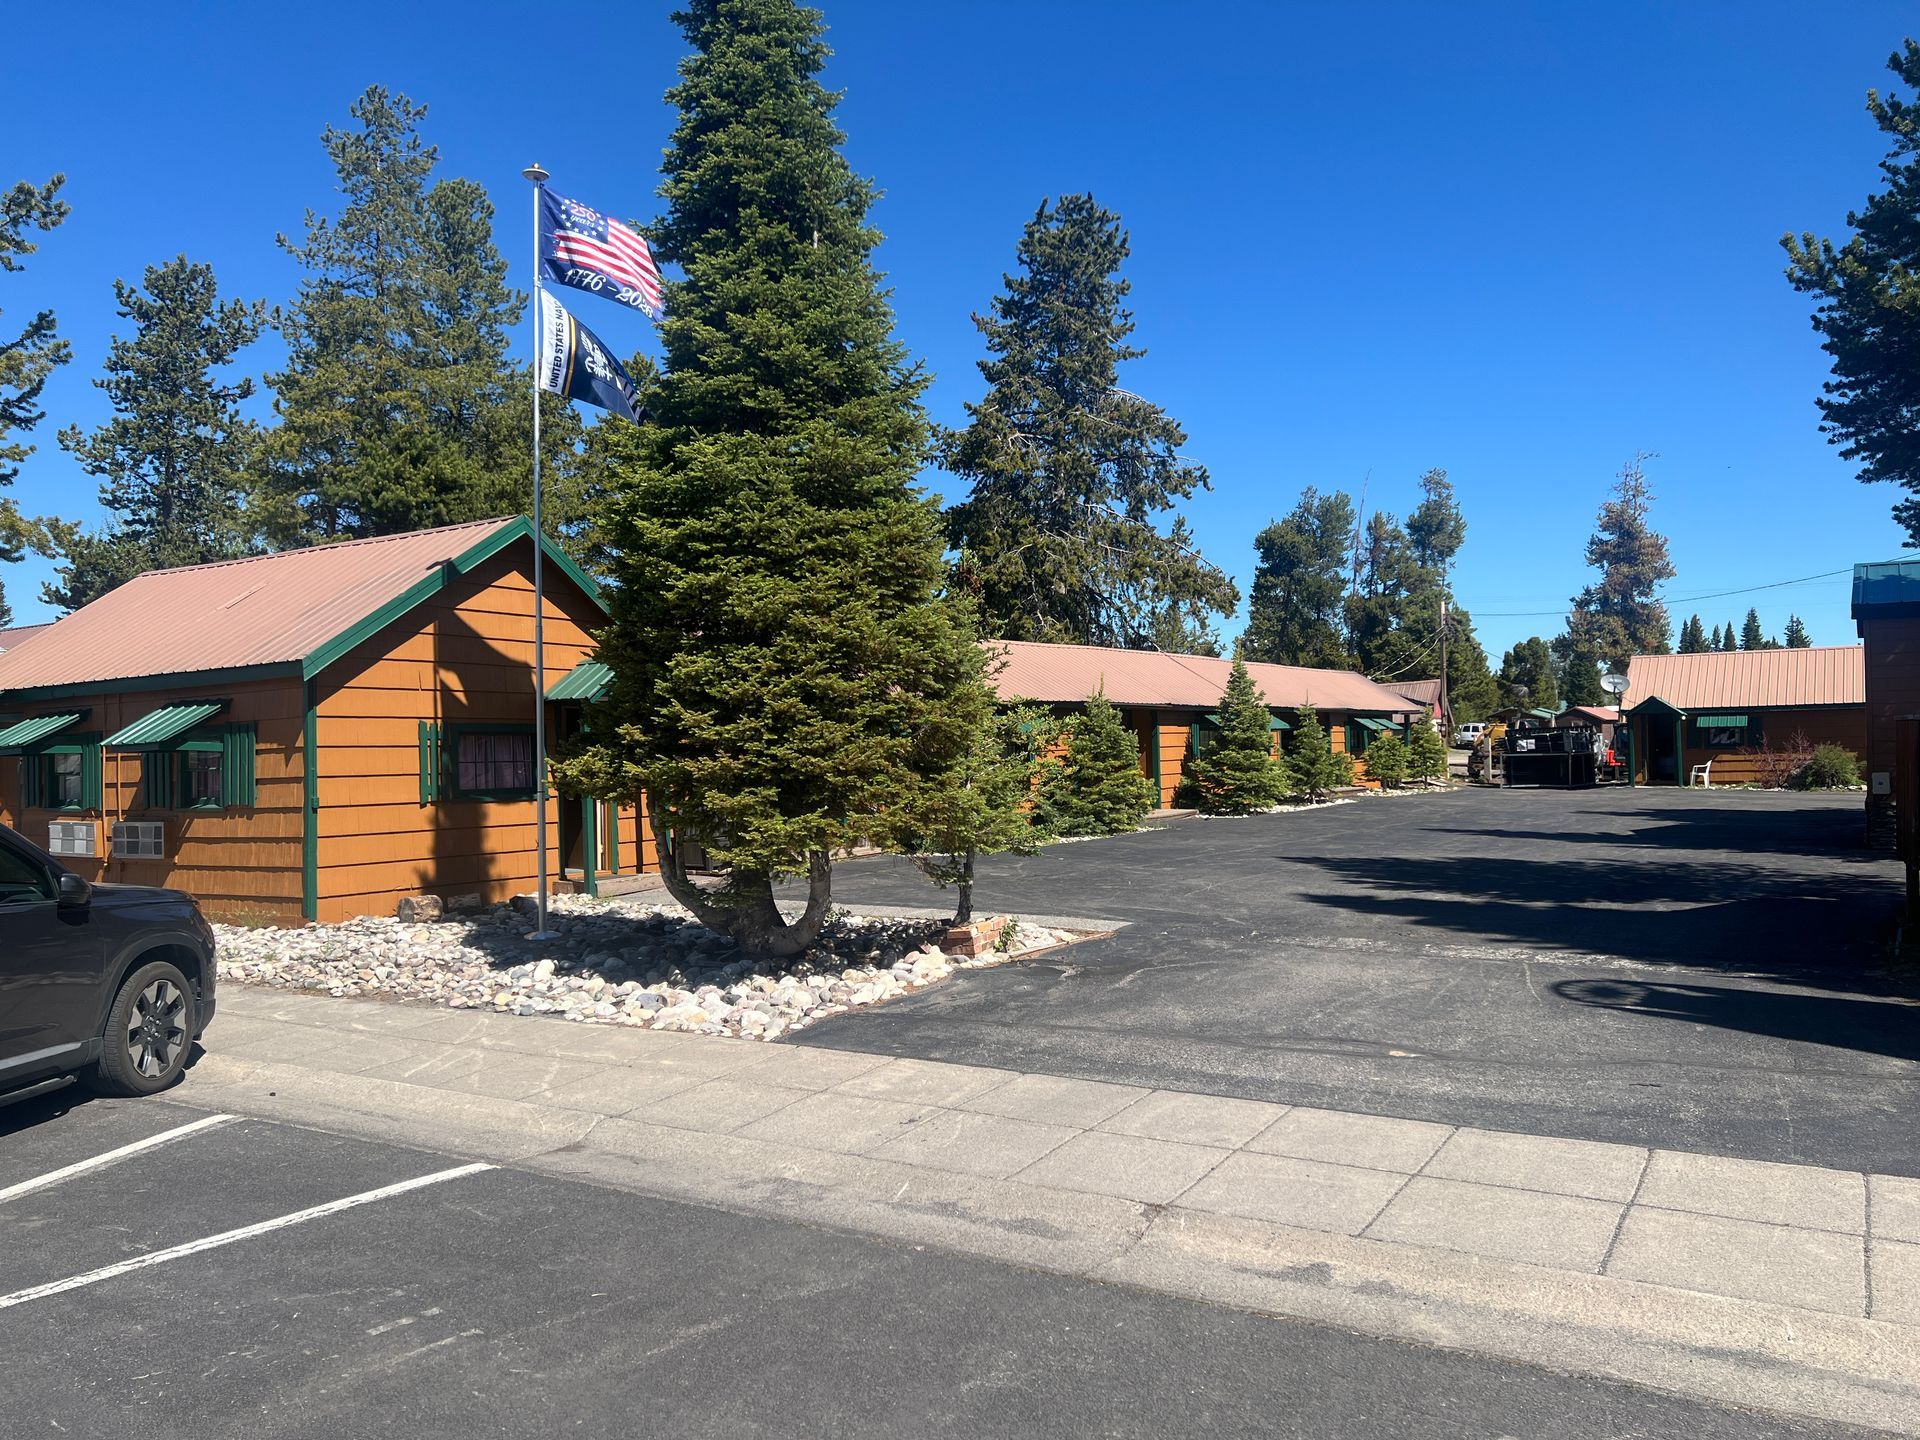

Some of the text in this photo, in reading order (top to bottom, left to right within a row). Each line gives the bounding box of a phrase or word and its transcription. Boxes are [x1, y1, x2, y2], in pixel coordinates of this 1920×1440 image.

[570, 203, 596, 222] 250
[570, 215, 595, 228] years
[564, 268, 607, 291] 1776
[554, 321, 565, 355] STATES
[549, 355, 563, 388] UNITED
